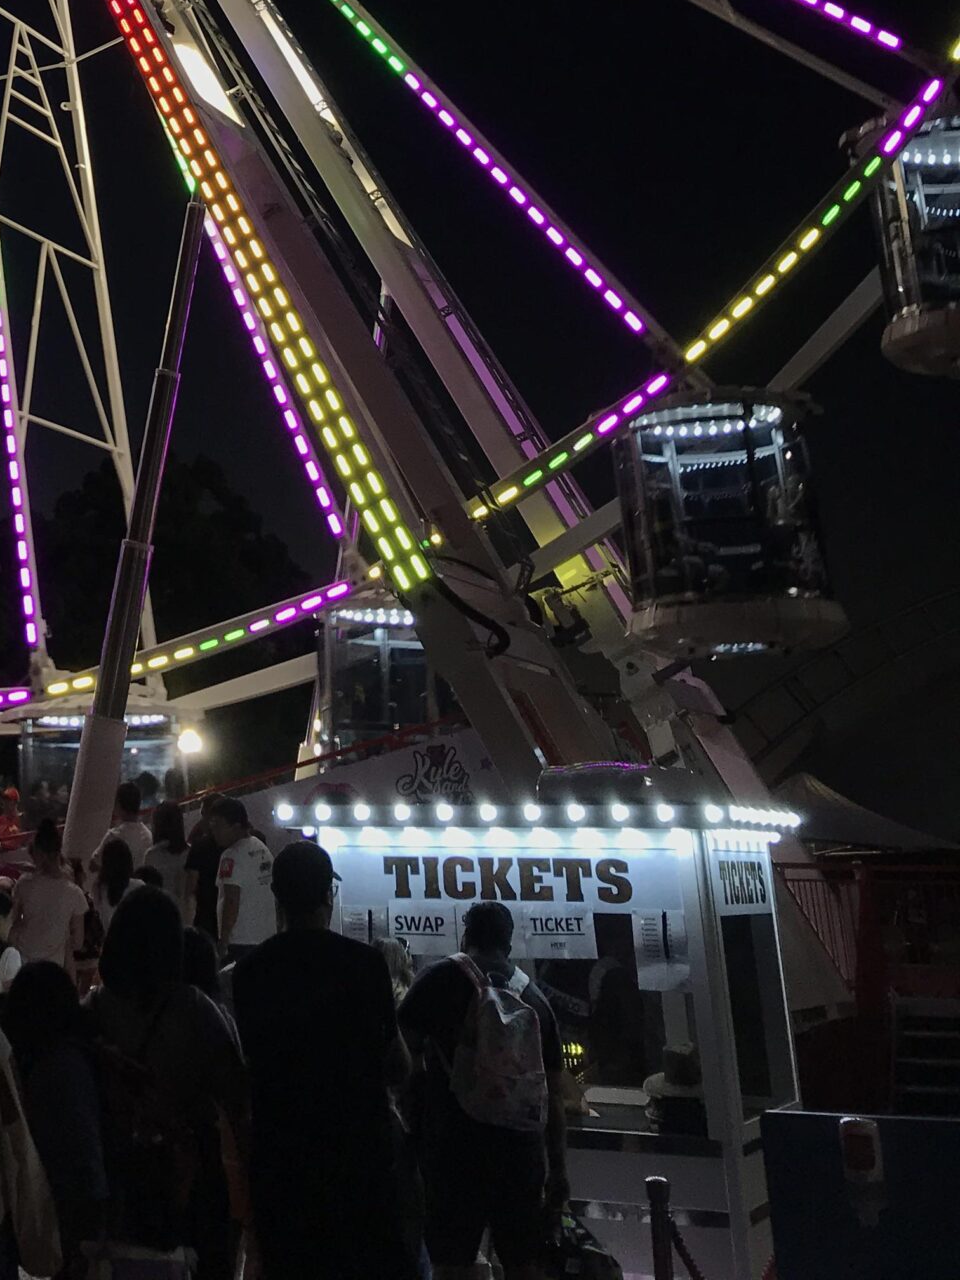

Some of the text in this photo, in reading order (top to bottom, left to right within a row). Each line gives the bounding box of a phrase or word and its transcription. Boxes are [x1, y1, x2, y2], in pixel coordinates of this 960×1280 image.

[396, 747, 461, 795] Kyle
[383, 856, 633, 904] TICKETS
[718, 860, 767, 905] TICKETS
[394, 915, 445, 933] SWAP
[530, 917, 584, 933] TICKET
